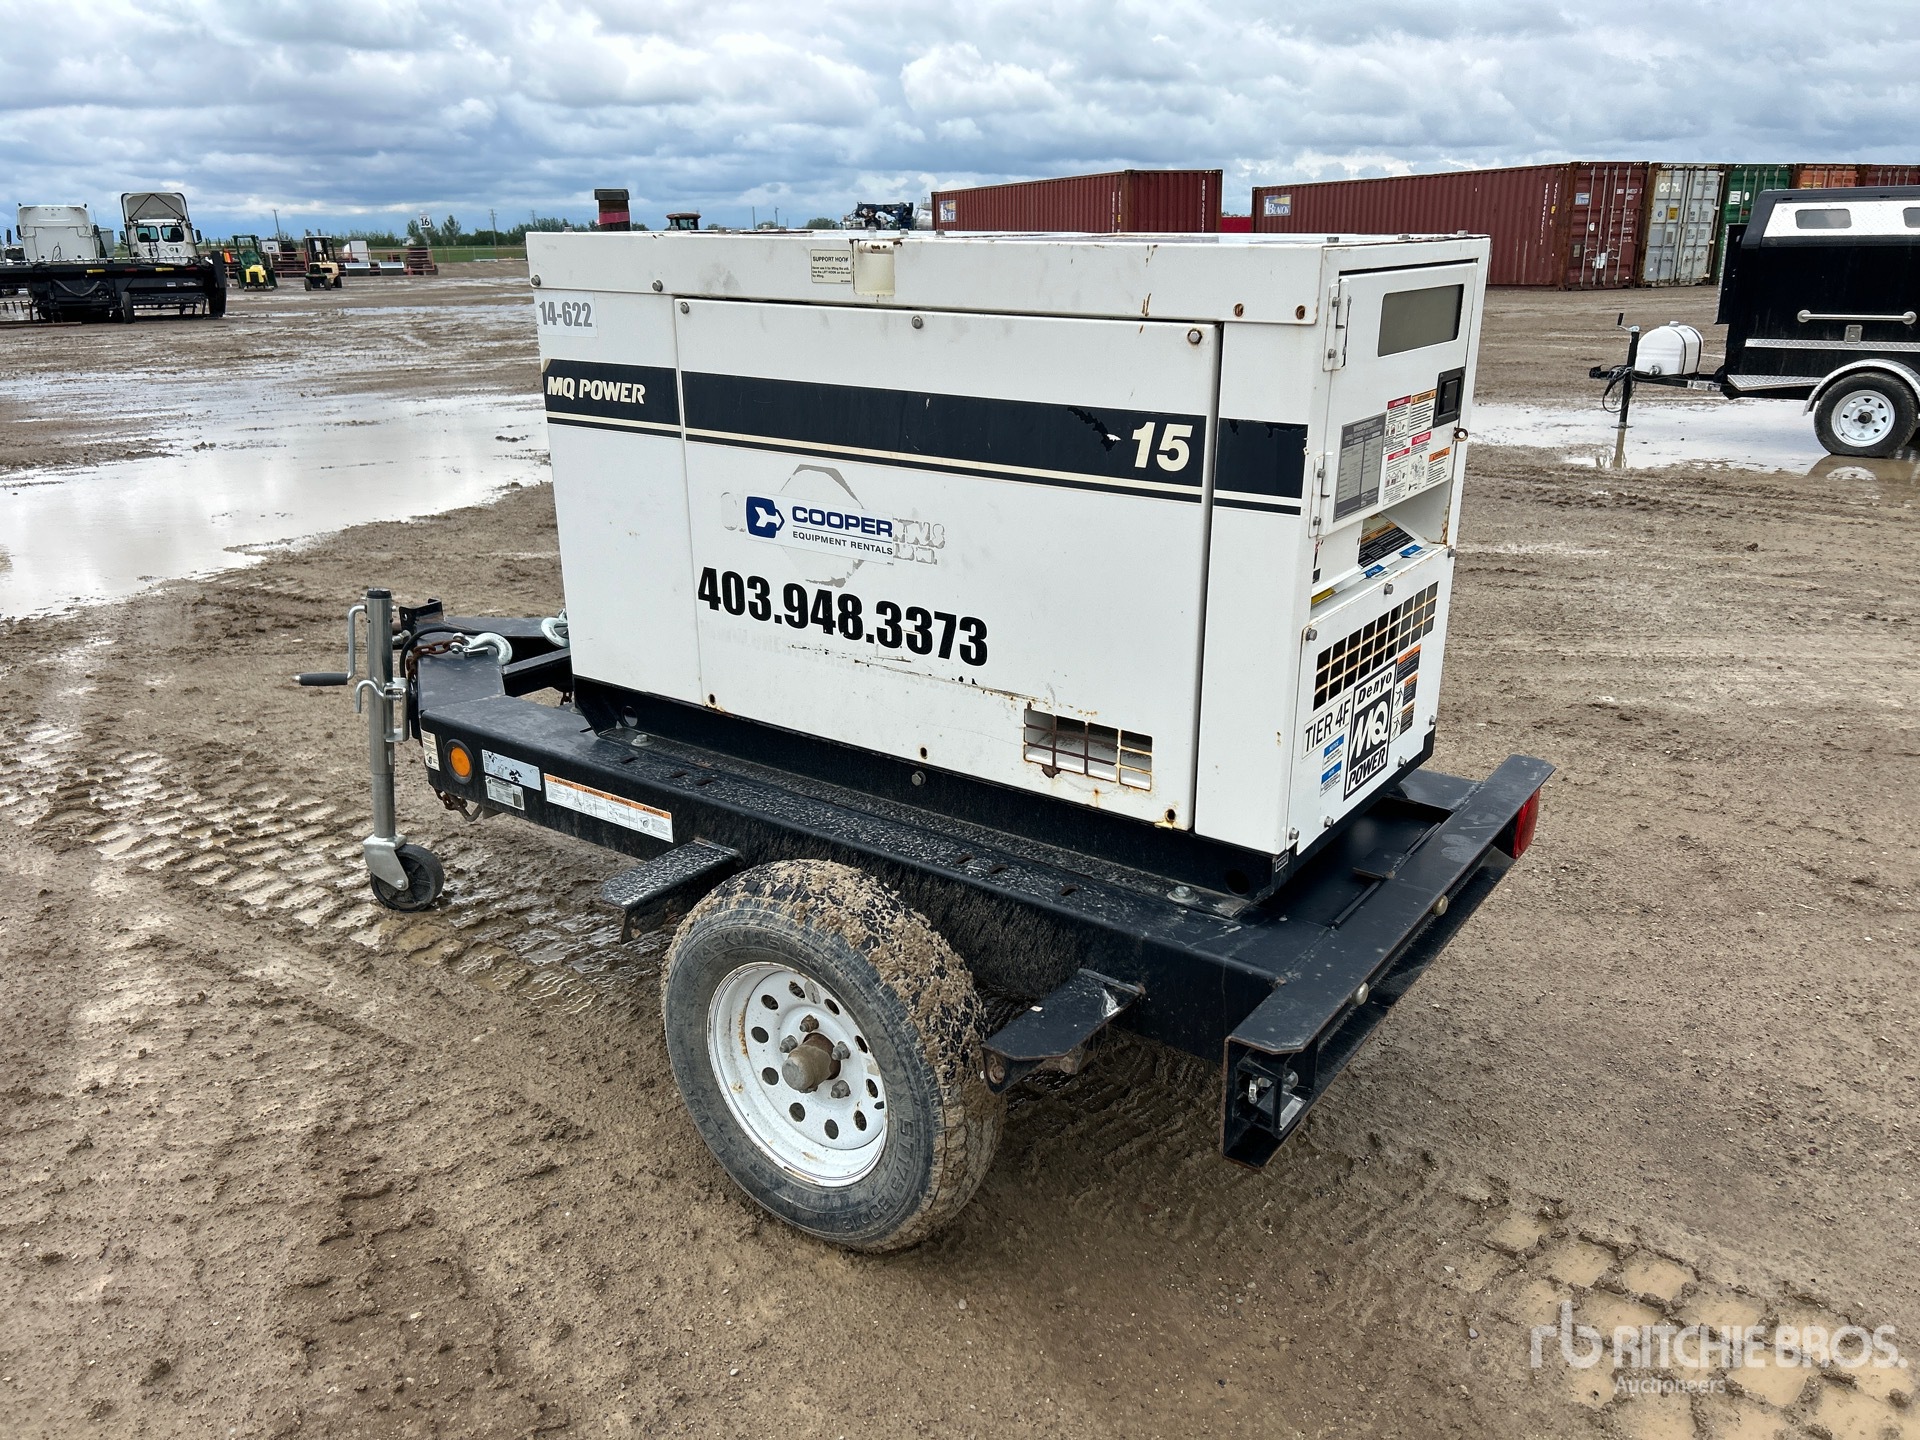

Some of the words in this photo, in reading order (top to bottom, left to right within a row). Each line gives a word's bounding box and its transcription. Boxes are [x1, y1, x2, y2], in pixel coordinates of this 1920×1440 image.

[419, 217, 430, 226] 16
[539, 301, 592, 327] 14-622
[547, 376, 576, 401] MQ
[578, 379, 646, 405] POWER
[1131, 421, 1194, 472] 15
[791, 505, 894, 538] COOPER
[792, 530, 855, 548] EQUIPMENT
[850, 541, 894, 556] RENTALS
[697, 566, 989, 668] 403.948.3373
[1357, 671, 1393, 705] Denyo
[1305, 712, 1333, 753] TIER
[1335, 699, 1351, 727] 4F
[1350, 700, 1390, 759] MQ
[1347, 747, 1386, 792] POWER
